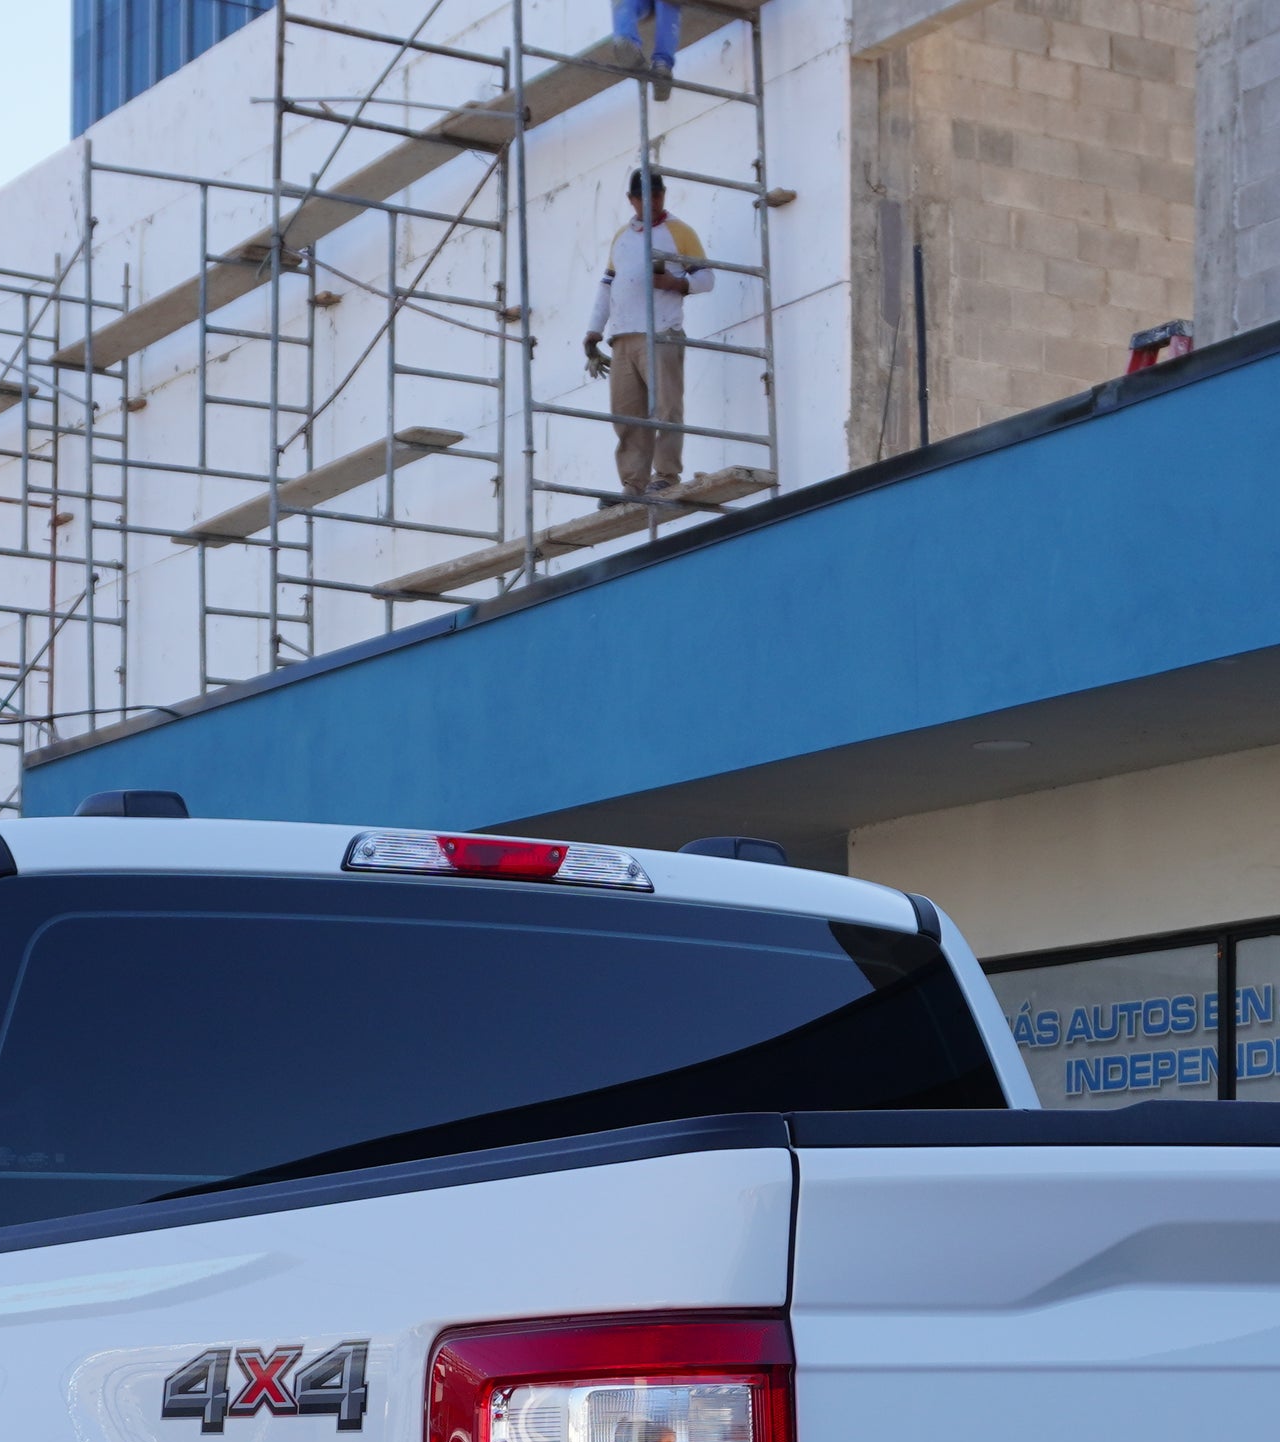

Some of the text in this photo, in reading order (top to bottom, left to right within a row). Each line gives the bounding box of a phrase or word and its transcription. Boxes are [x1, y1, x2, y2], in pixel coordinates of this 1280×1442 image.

[1005, 999, 1060, 1048] ÁS
[1063, 993, 1197, 1045] AUTOS
[1202, 983, 1273, 1031] EN
